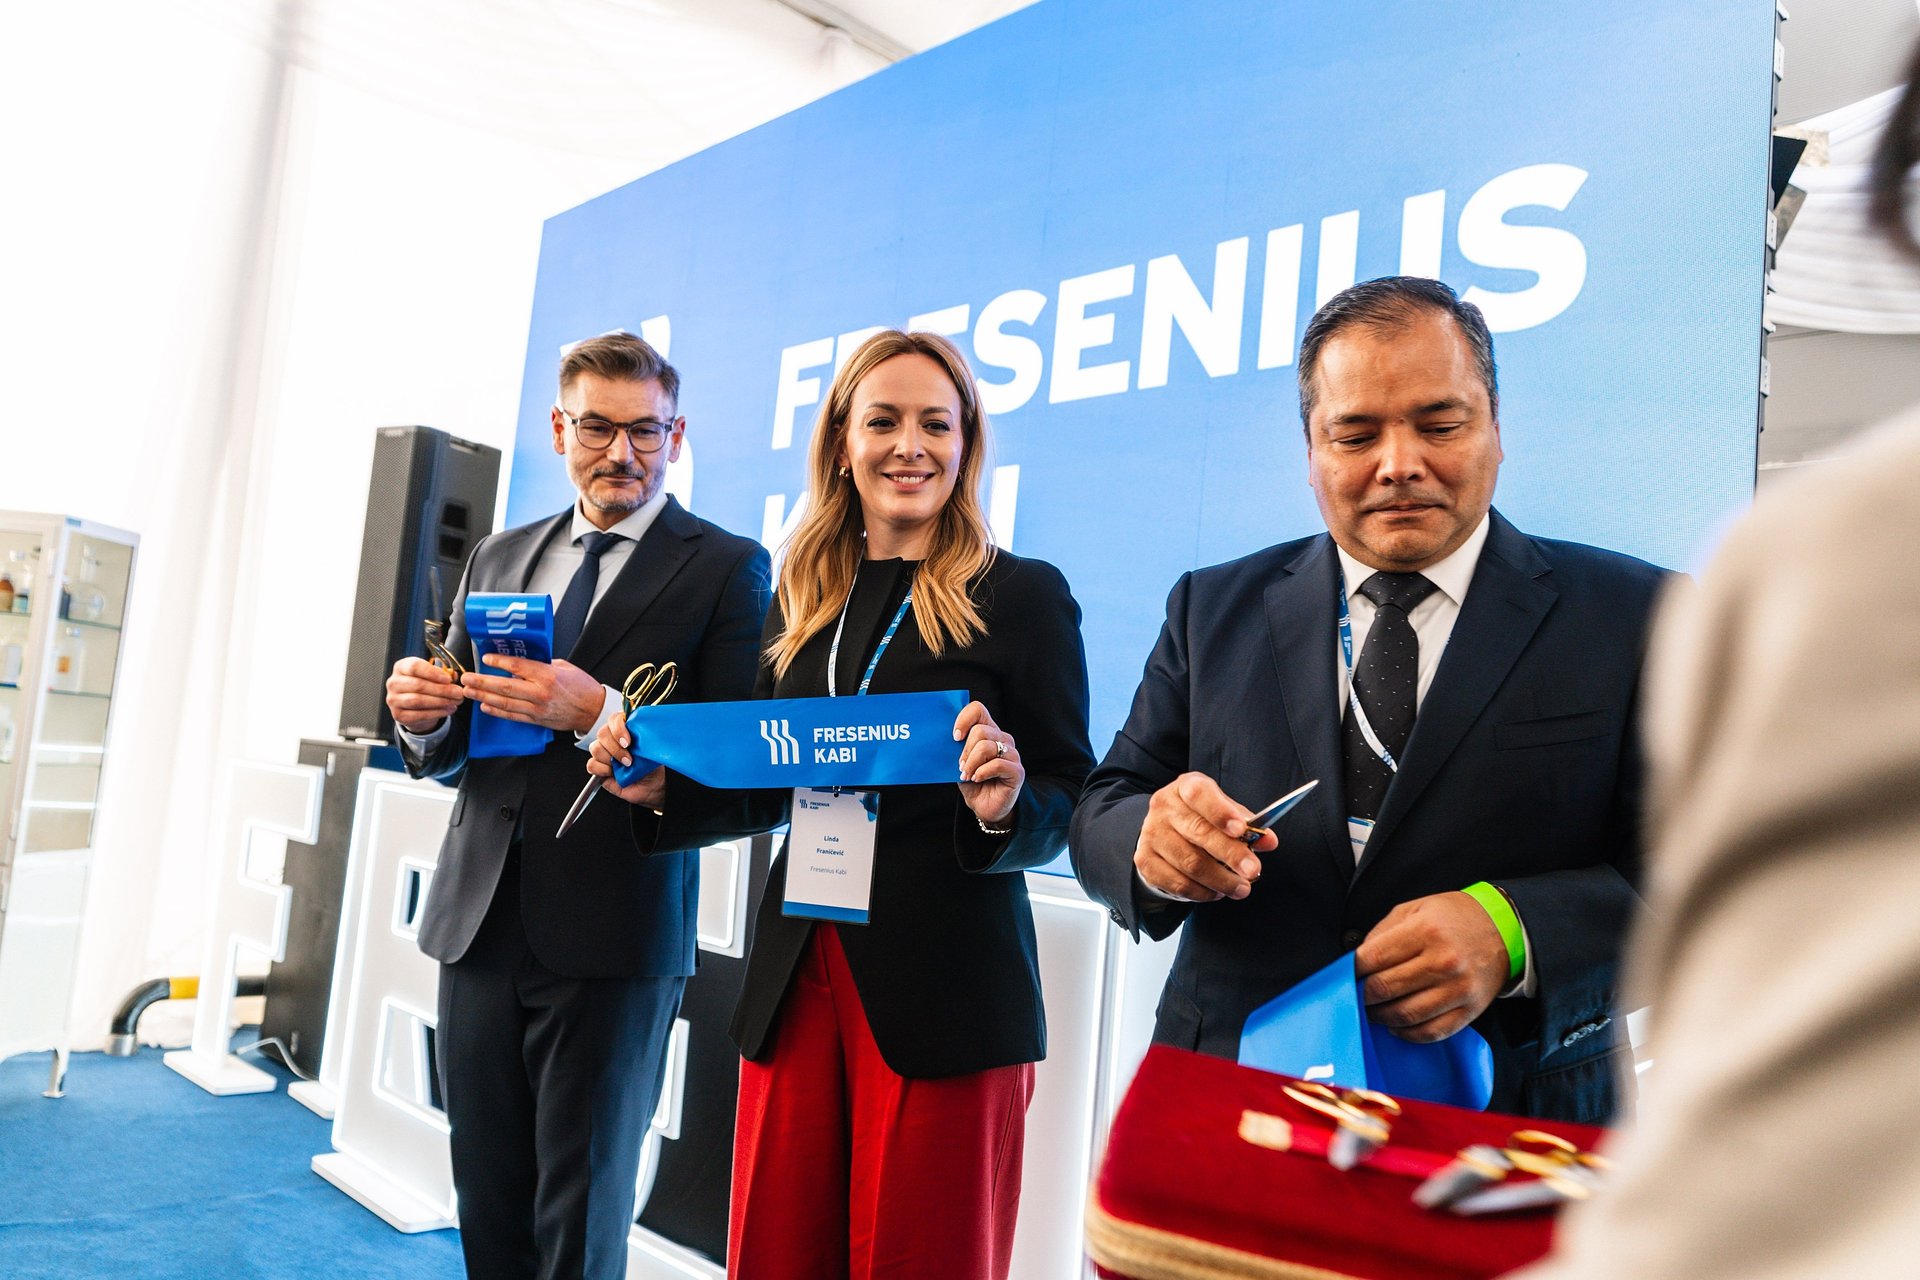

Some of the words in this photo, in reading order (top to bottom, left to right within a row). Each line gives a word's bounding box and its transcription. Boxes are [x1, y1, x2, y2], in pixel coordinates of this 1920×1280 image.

[771, 163, 1588, 449] FSENIUS
[813, 724, 911, 743] FRESENIUS
[814, 747, 857, 764] KABI
[810, 865, 835, 874] Fresenius
